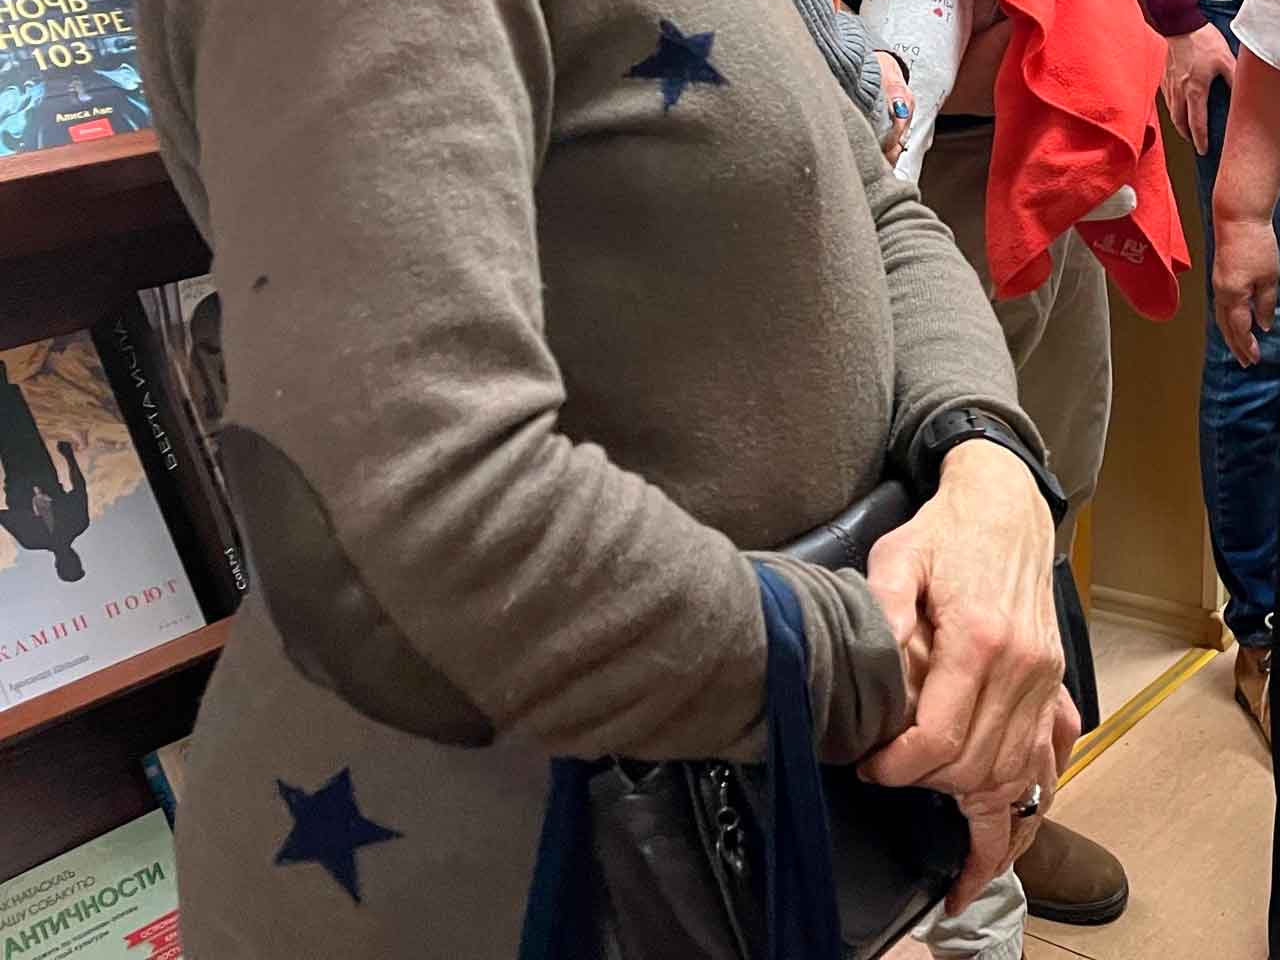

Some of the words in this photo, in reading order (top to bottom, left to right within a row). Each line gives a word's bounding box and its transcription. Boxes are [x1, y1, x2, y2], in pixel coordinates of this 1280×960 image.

[0, 10, 132, 50] НОМЕРЕ
[32, 41, 93, 71] 103
[105, 579, 178, 618] ПОЮТ
[5, 861, 166, 960] АНТИЧНОСТИ
